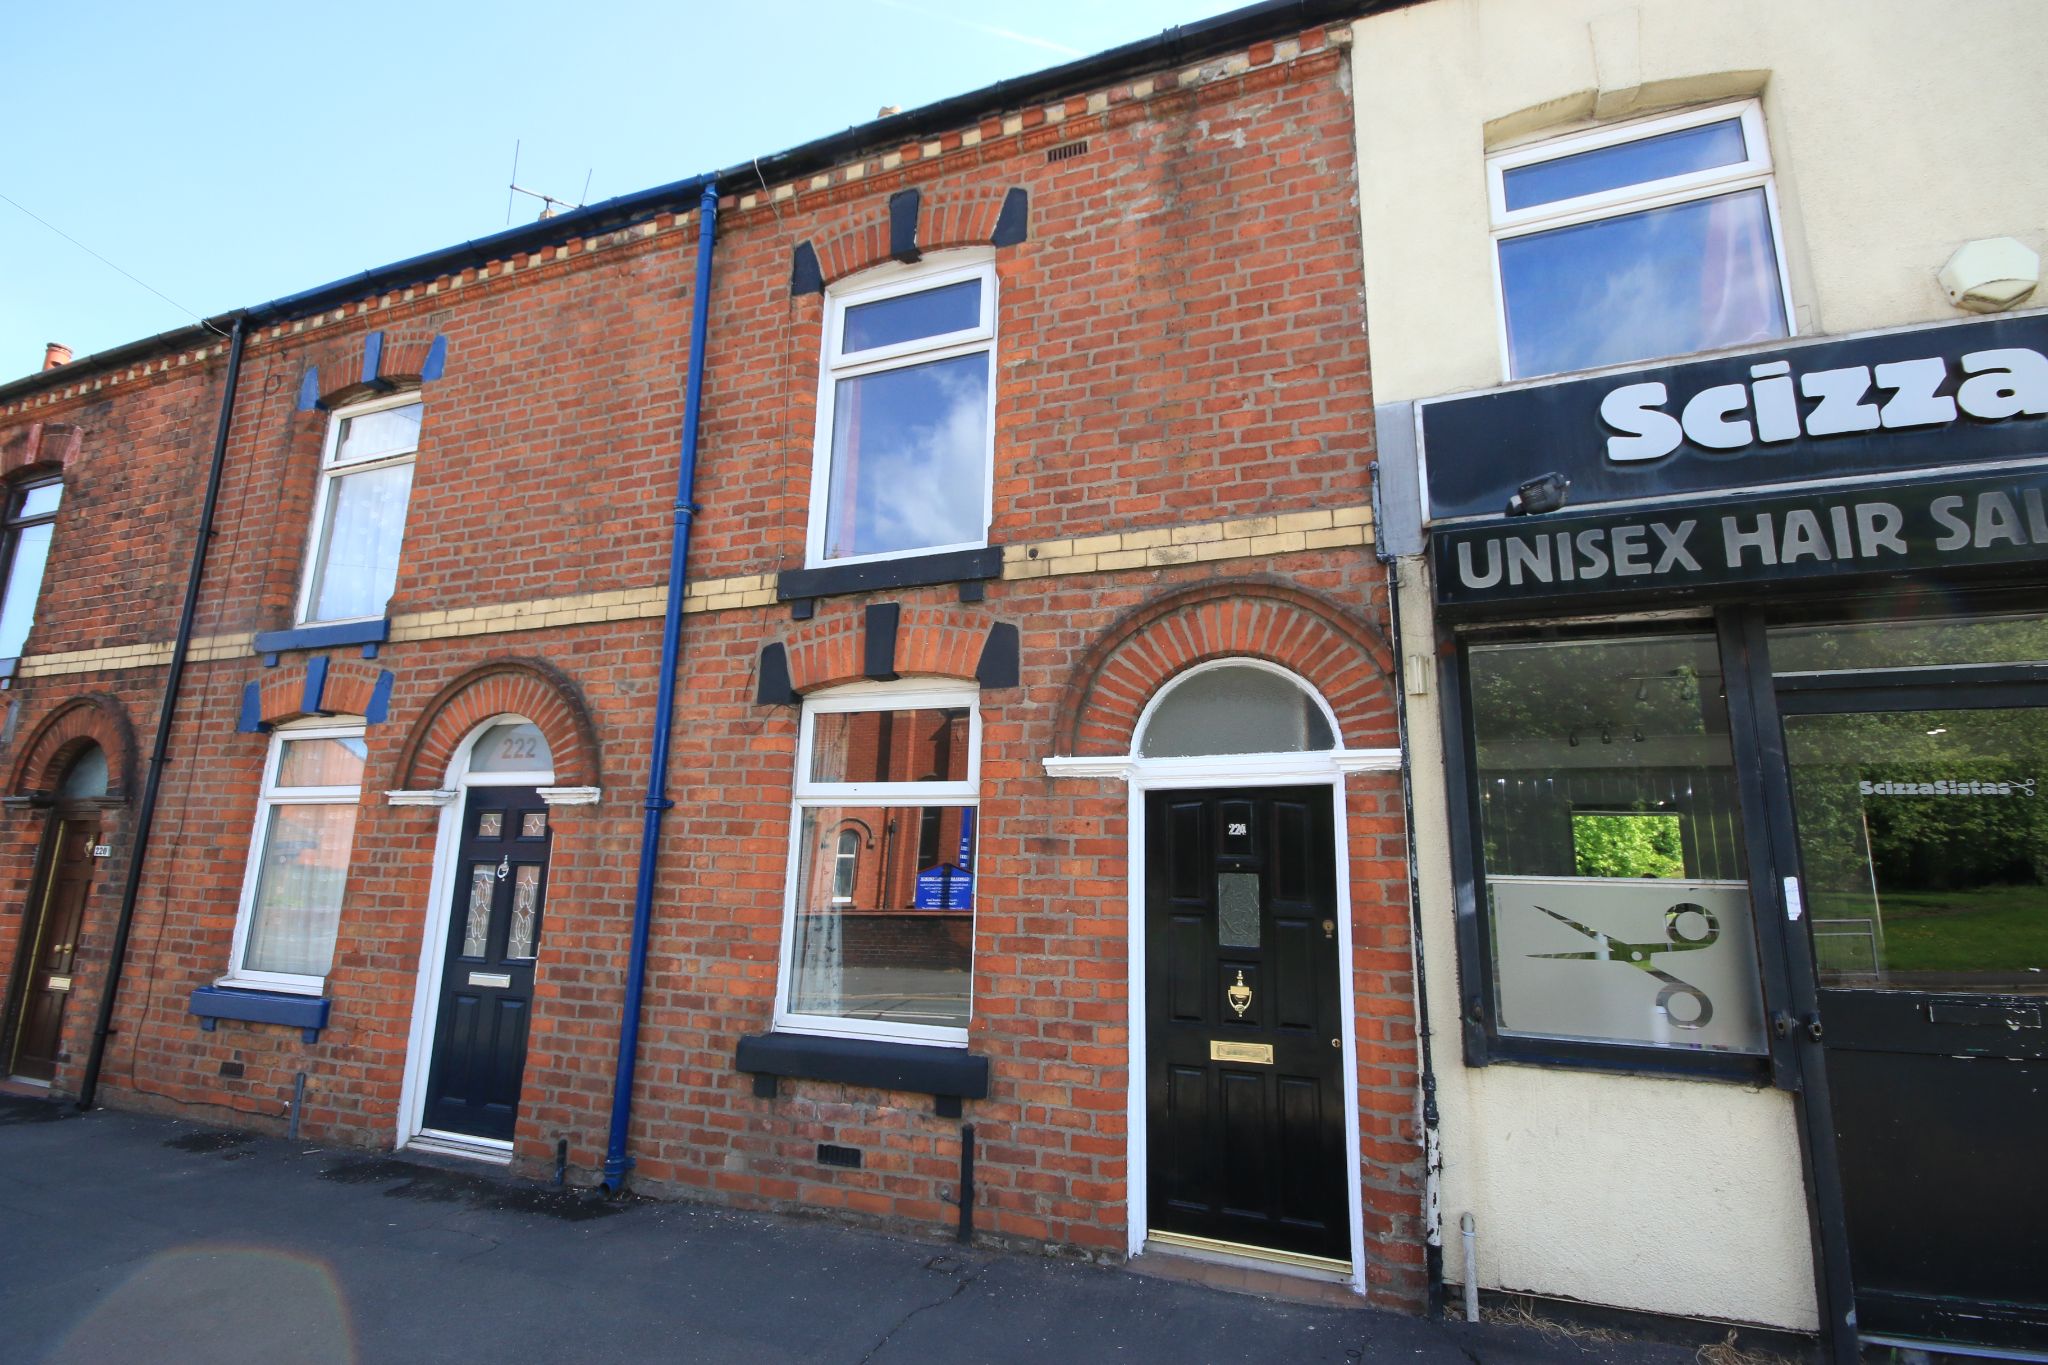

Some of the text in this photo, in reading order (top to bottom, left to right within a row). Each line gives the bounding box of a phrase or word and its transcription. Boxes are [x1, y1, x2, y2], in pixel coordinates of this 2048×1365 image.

[1600, 348, 2048, 461] Scizza
[1457, 519, 1701, 589] UNISEX
[1722, 502, 1907, 568] HAIR
[501, 737, 537, 759] 222
[1859, 780, 2011, 795] ScizzaSistas
